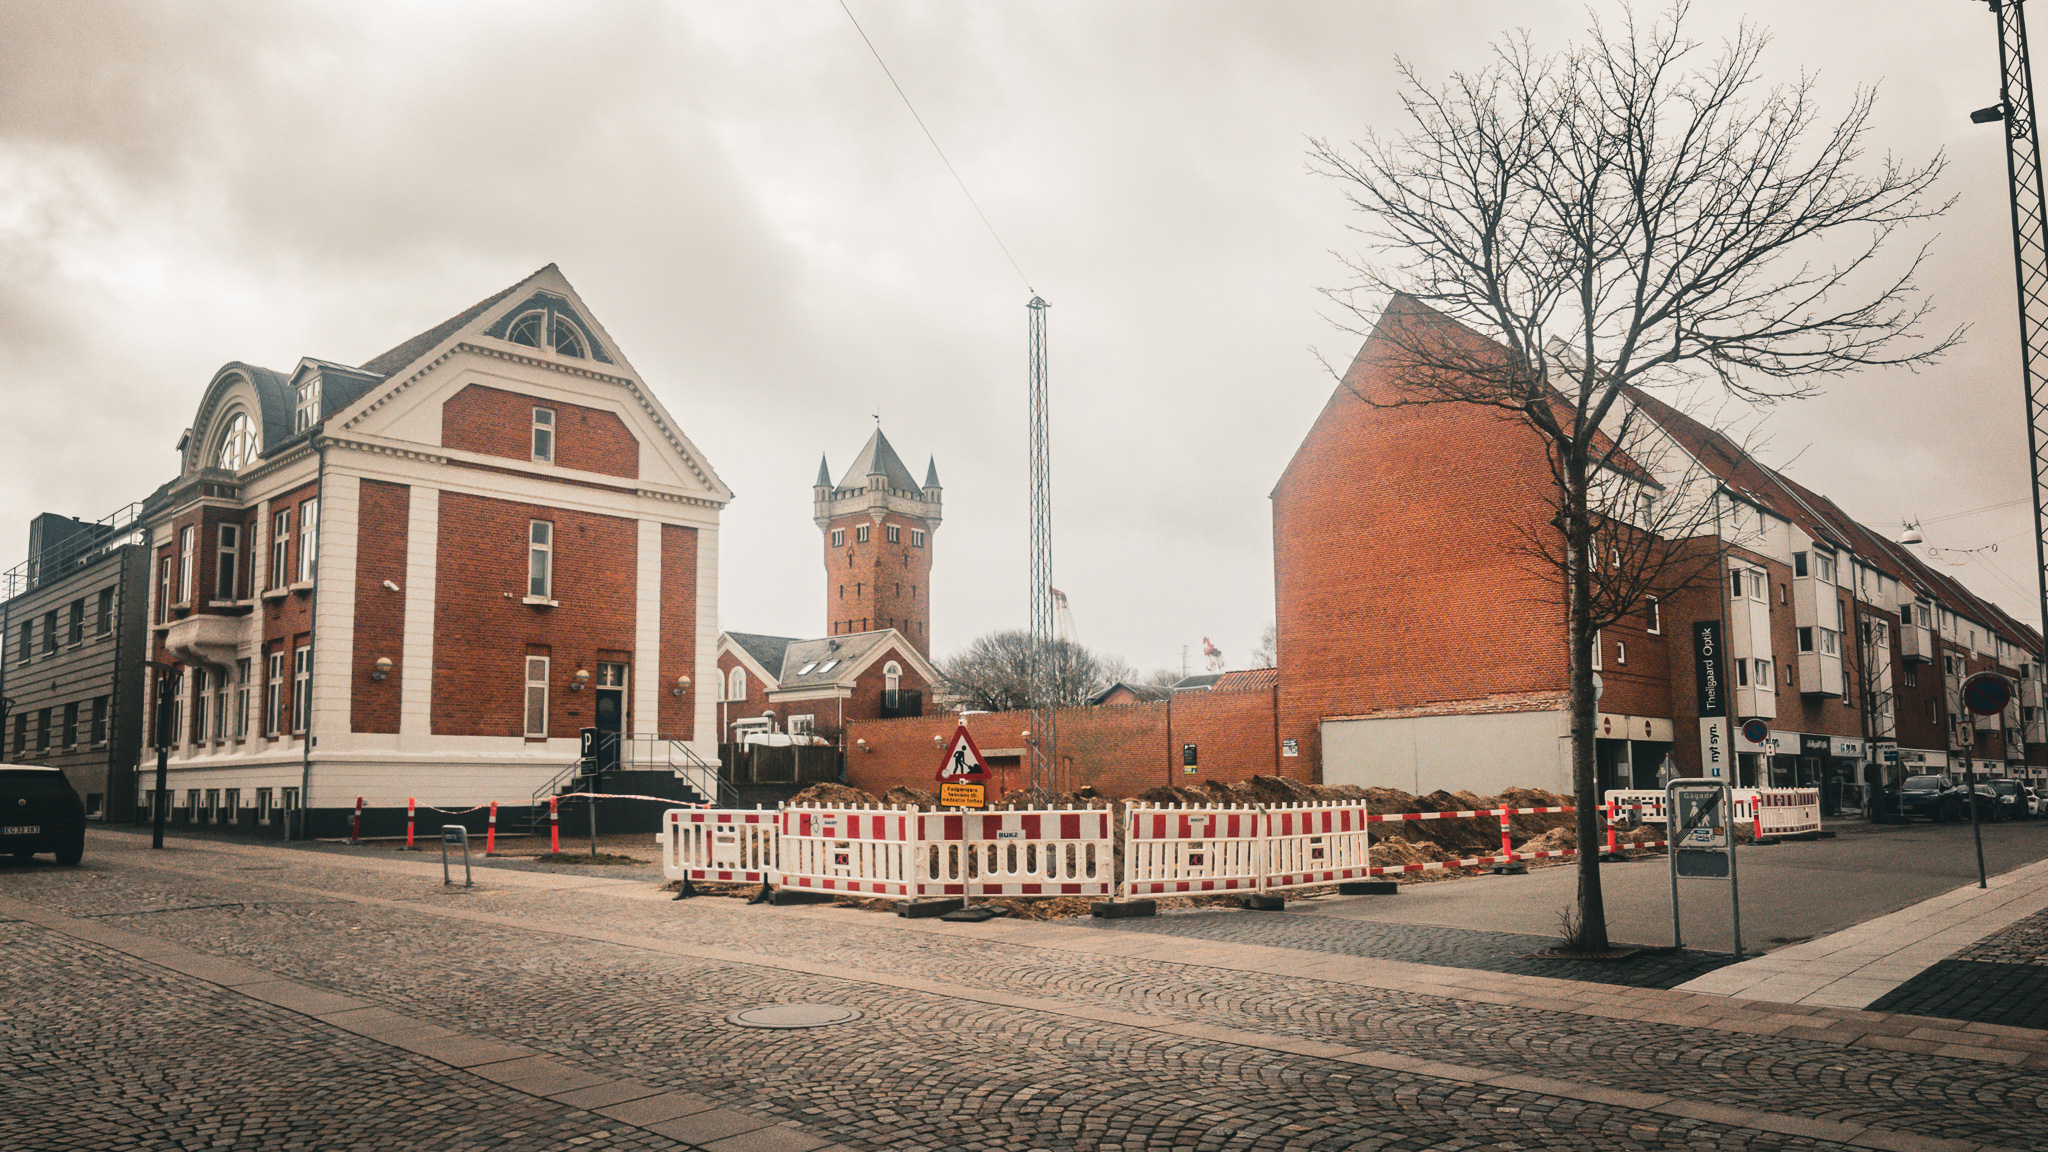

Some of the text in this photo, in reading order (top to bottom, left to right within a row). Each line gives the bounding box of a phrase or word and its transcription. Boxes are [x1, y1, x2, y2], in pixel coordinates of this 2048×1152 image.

[1701, 627, 1717, 710] Theilgaard Optik
[585, 733, 592, 753] P
[1709, 723, 1720, 762] nyt syn.
[836, 854, 849, 865] AO
[1190, 854, 1203, 865] AO
